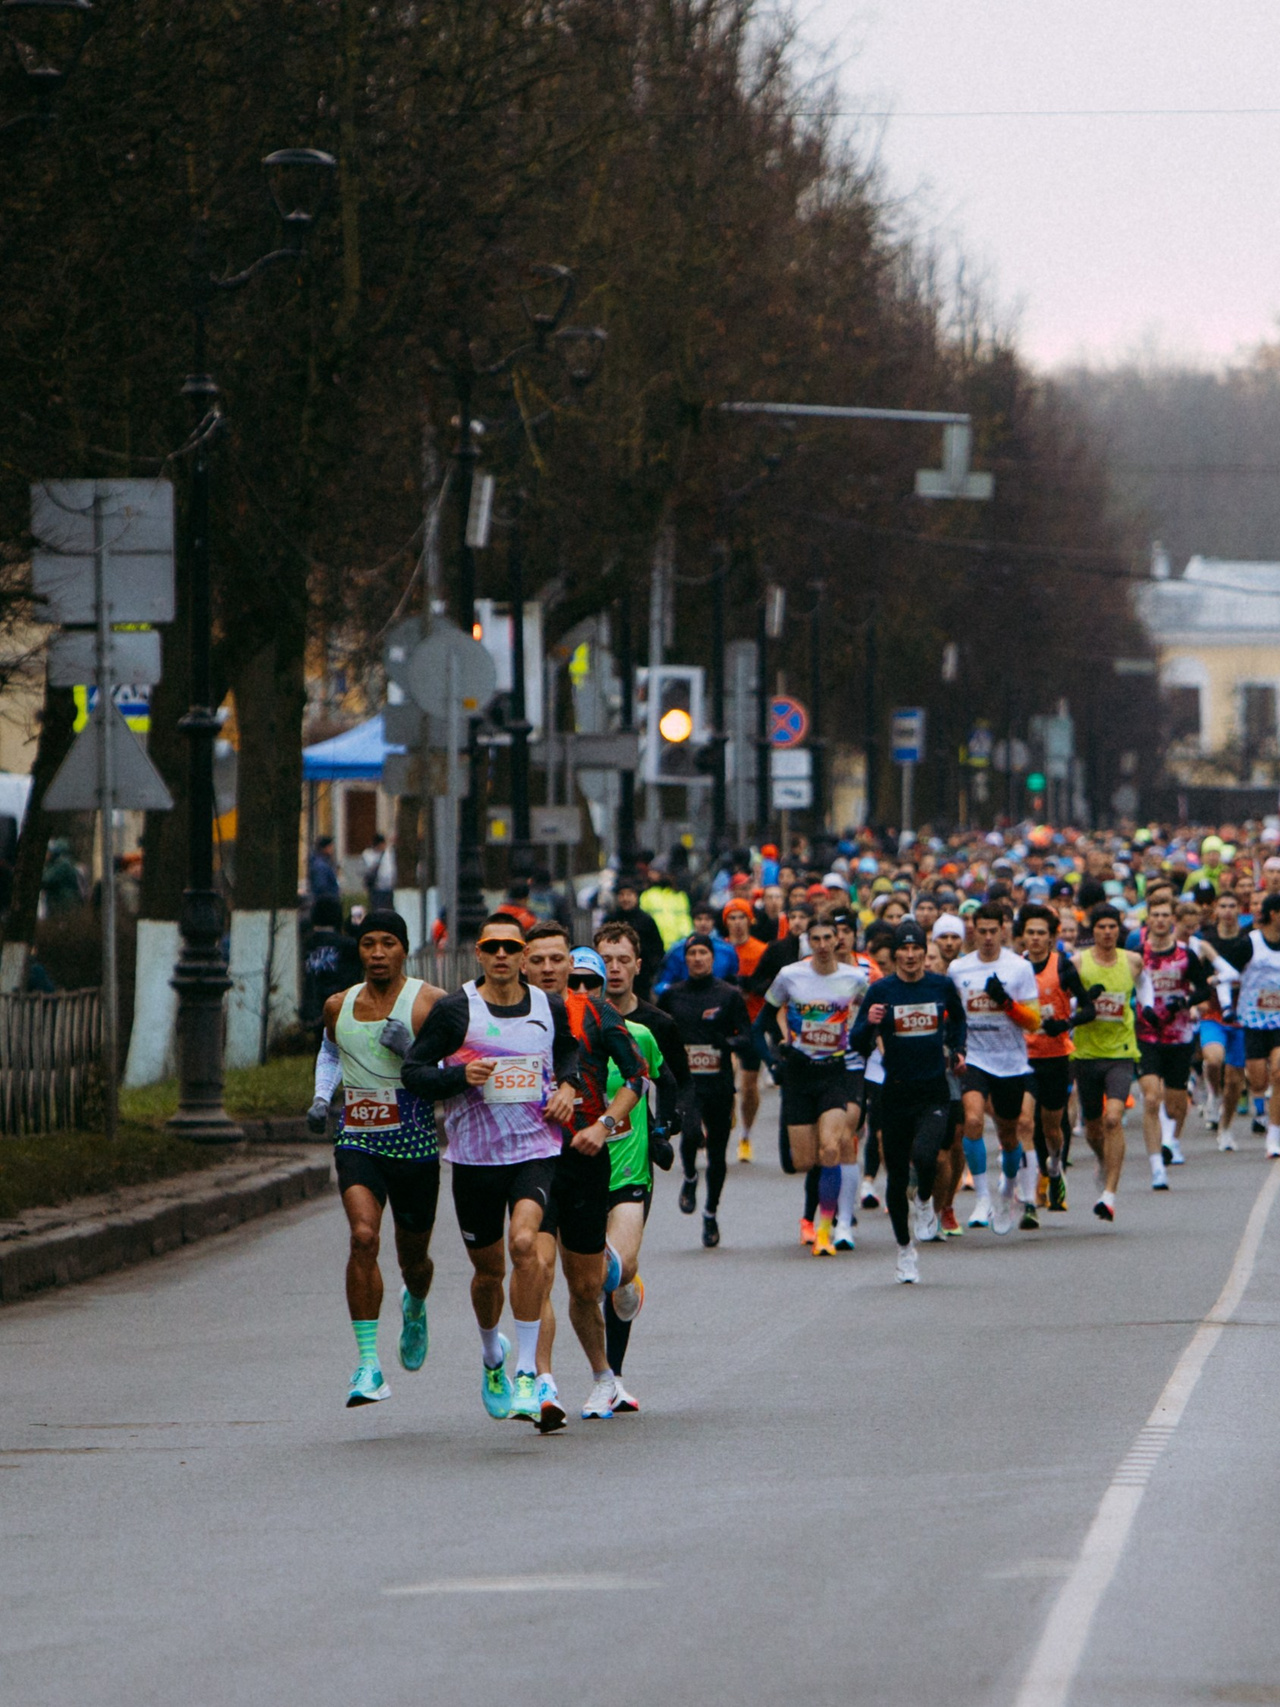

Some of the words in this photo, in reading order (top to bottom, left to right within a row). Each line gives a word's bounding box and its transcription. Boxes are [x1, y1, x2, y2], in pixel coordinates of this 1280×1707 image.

[902, 1016, 933, 1028] 3301
[494, 1074, 536, 1090] 5522
[350, 1104, 391, 1120] 4872
